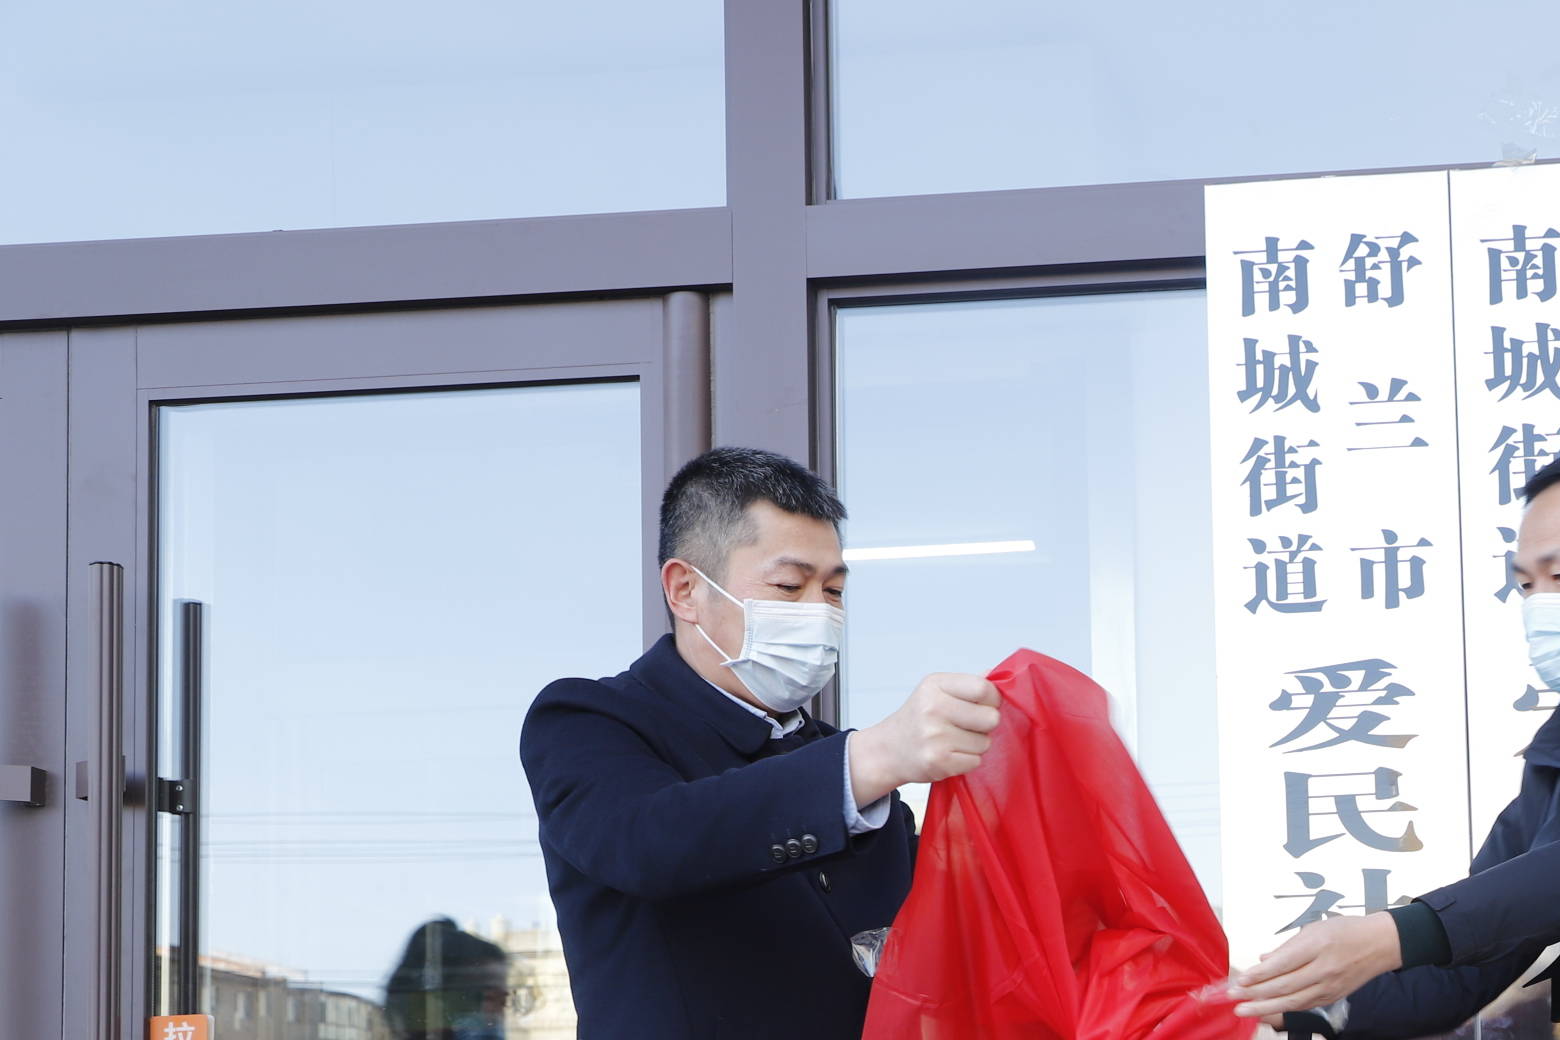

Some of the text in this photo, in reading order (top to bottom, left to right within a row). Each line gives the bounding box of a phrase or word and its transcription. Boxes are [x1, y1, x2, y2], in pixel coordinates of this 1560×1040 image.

[1232, 236, 1329, 615] 南城街道
[1338, 230, 1434, 610] 舒兰市
